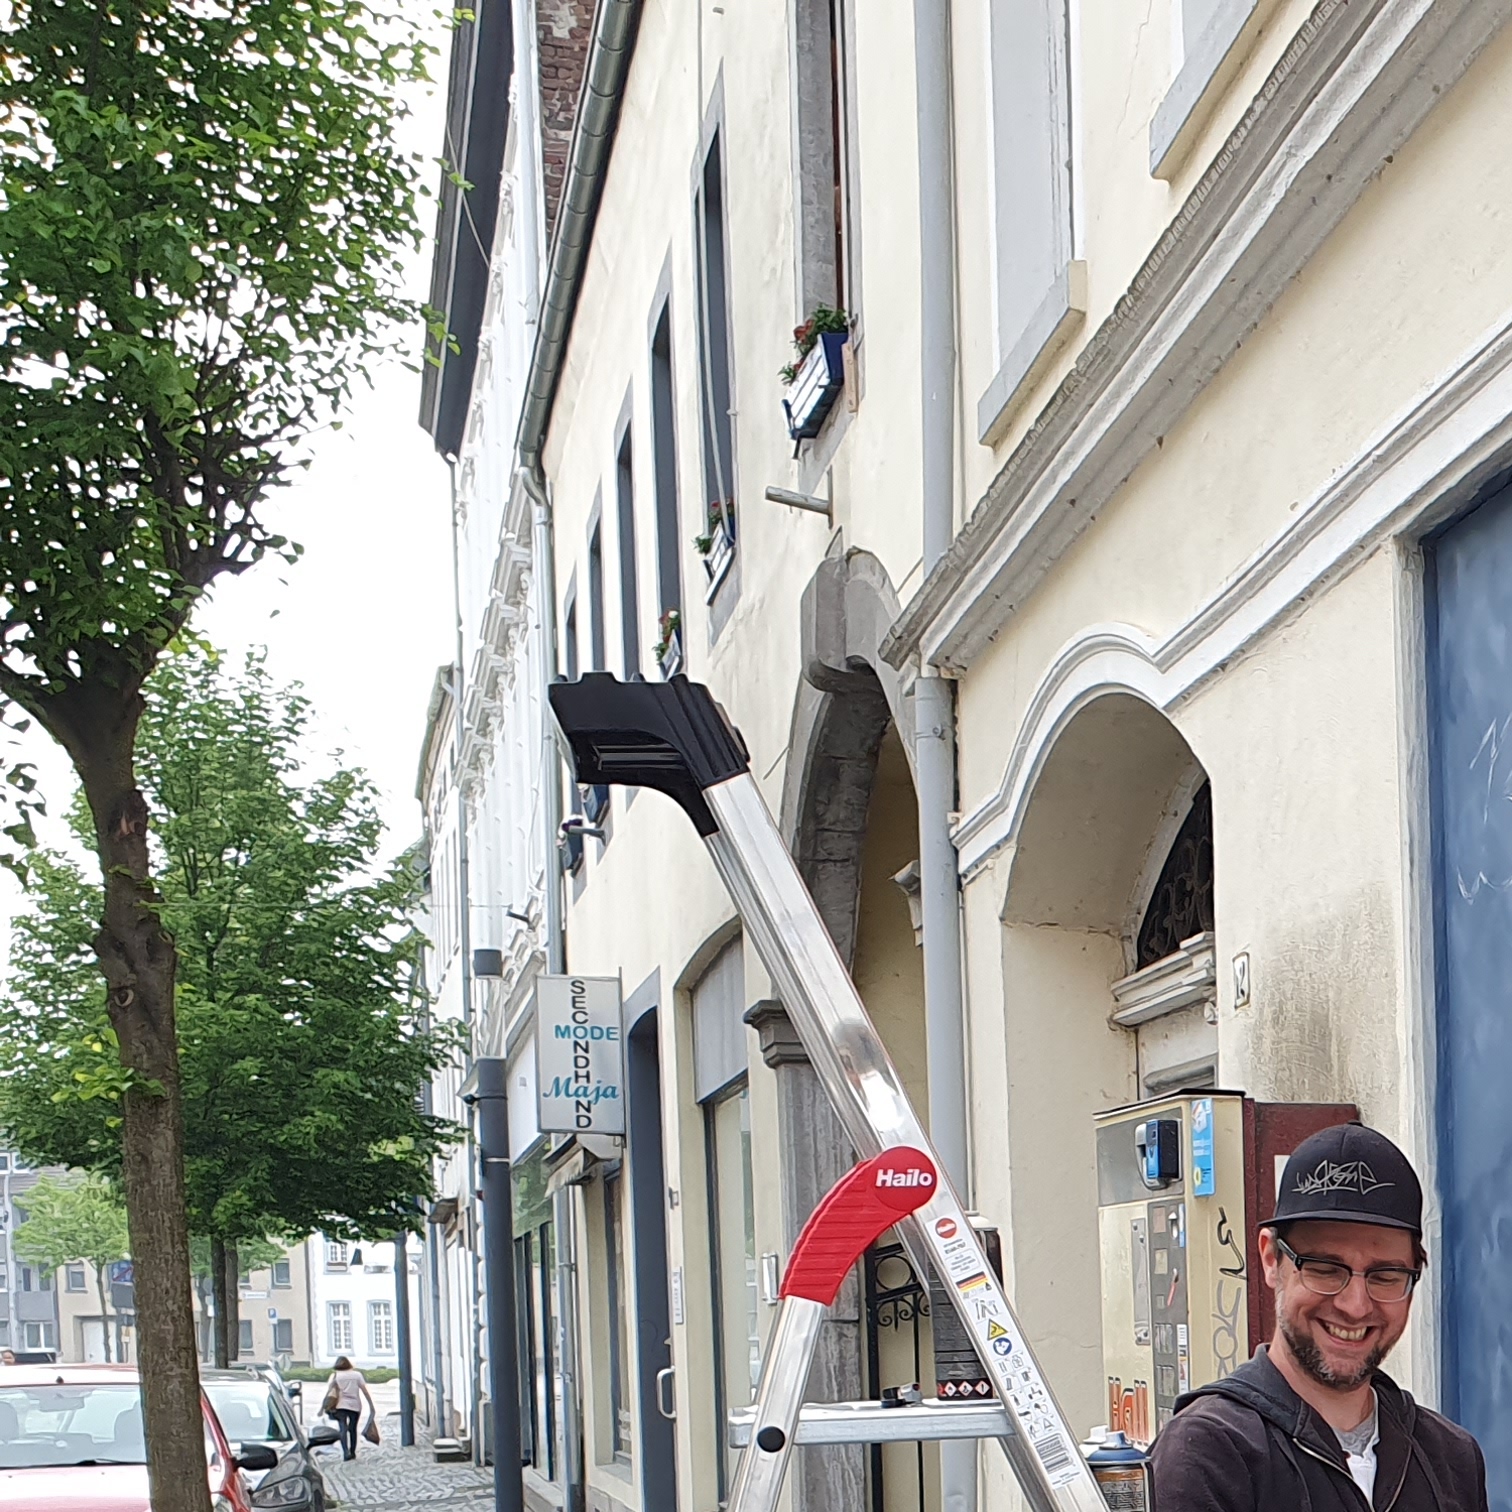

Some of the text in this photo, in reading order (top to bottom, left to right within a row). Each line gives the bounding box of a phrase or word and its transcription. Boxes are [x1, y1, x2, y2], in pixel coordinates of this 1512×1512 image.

[554, 1024, 619, 1041] MODE
[542, 1076, 620, 1106] Maja
[875, 1168, 932, 1187] Hailo
